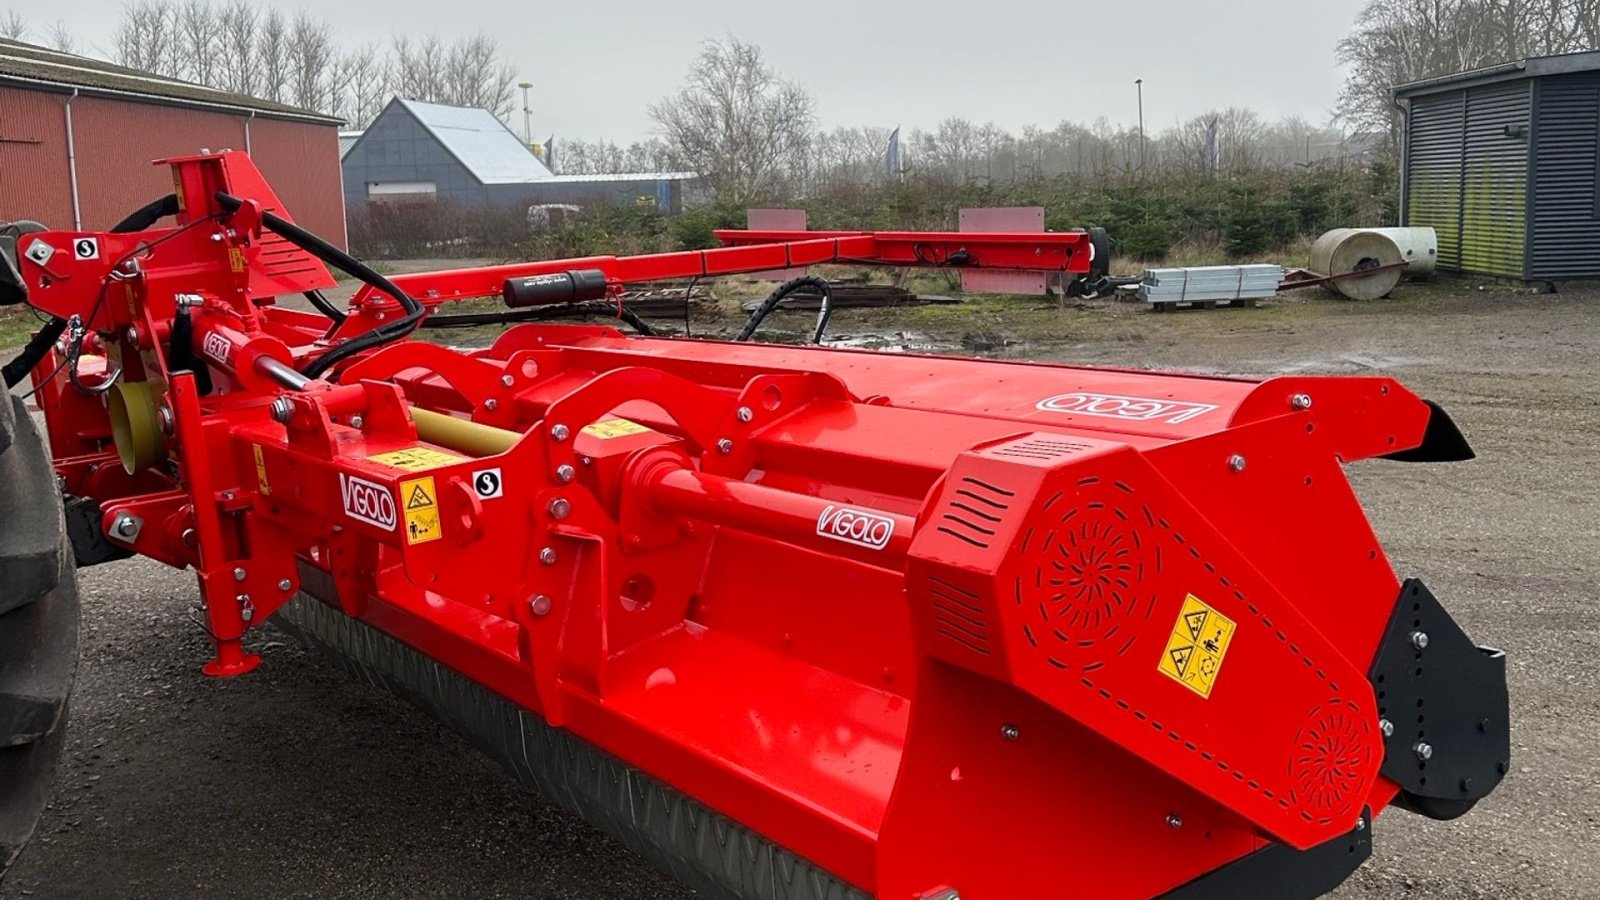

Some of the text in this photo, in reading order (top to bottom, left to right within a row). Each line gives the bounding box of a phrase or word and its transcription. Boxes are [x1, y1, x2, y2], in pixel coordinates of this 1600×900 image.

[203, 331, 230, 363] VIGOLO
[1036, 392, 1218, 424] VIGOLO
[339, 472, 395, 530] VIGOLO
[817, 505, 894, 549] VIGOLO
